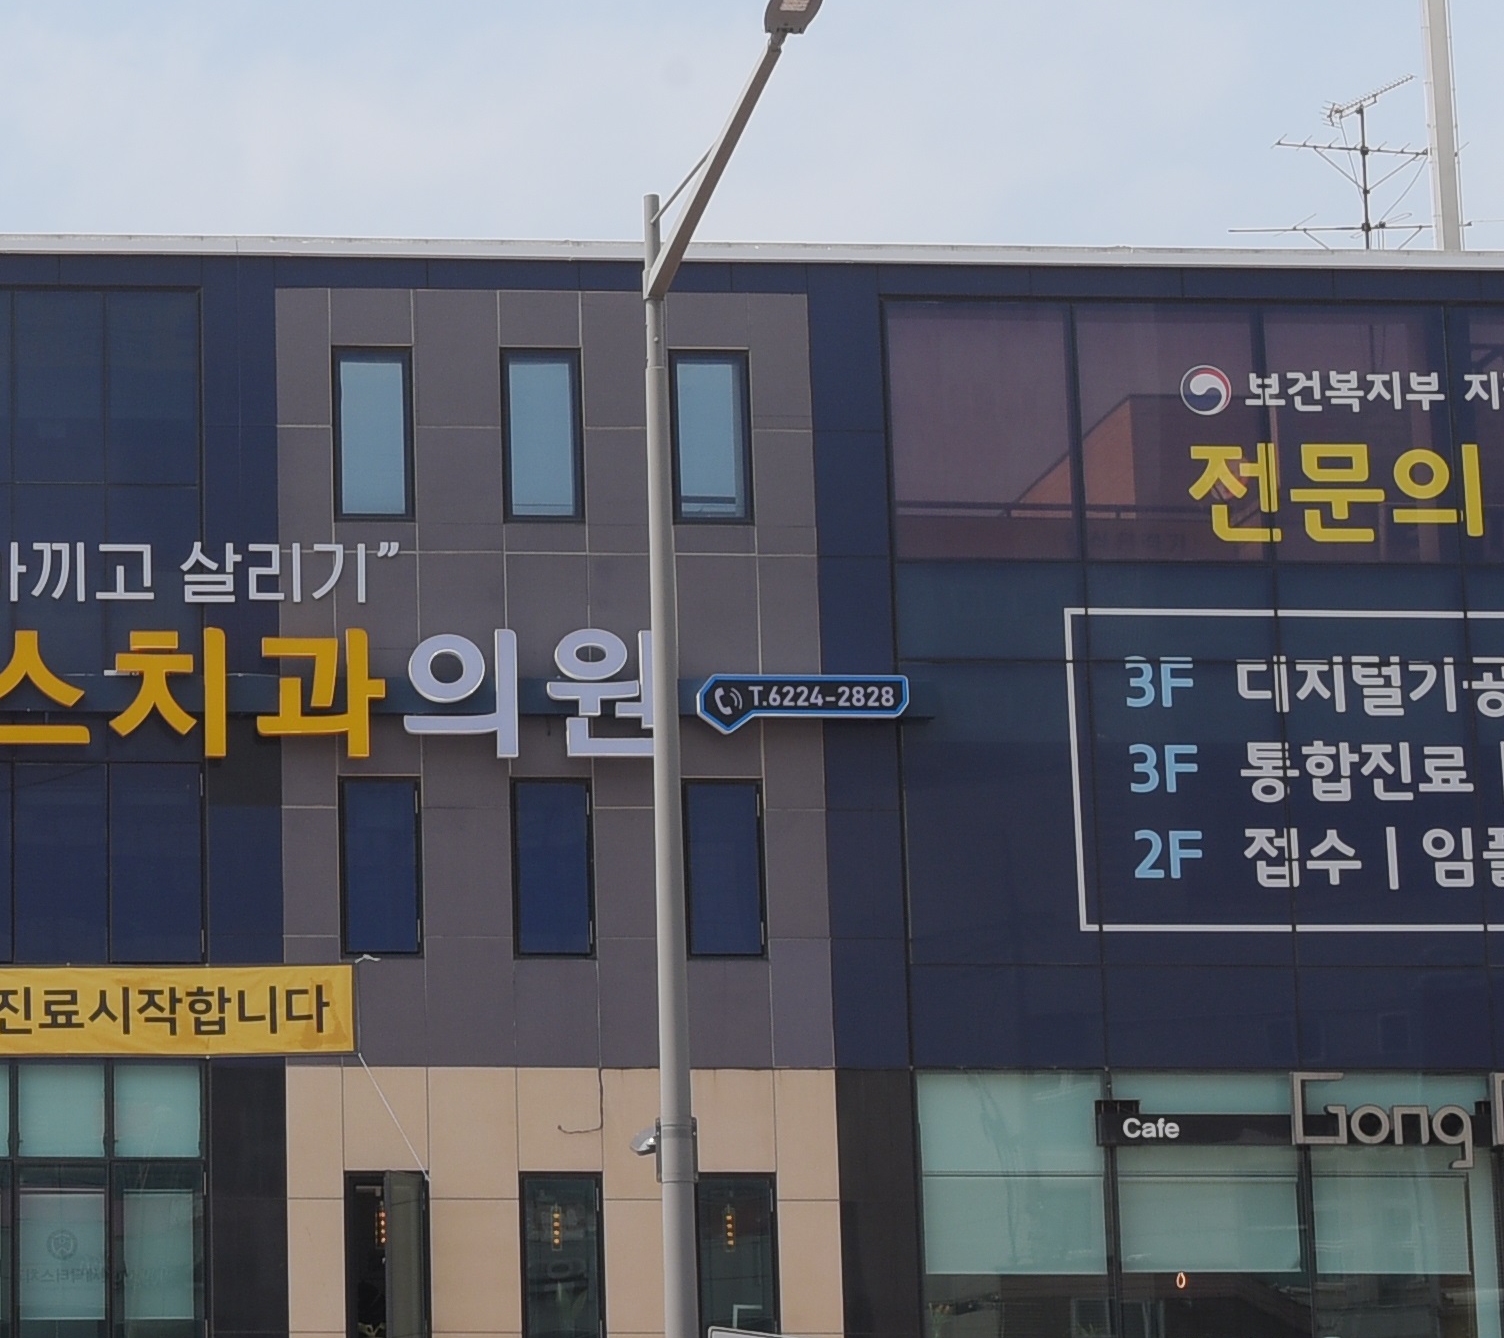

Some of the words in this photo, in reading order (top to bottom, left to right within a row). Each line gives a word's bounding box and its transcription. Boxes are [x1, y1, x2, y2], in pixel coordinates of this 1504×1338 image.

[1246, 370, 1445, 413] 보건복지부
[1188, 442, 1484, 544] 전문의
[747, 681, 896, 710] T.6224-2828
[1124, 655, 1194, 709] 3F
[1129, 743, 1198, 795] 3F
[1239, 742, 1475, 802] 통합진료
[1134, 829, 1202, 879] 2F
[1243, 827, 1364, 888] 접수
[1122, 1117, 1180, 1139] Cafe
